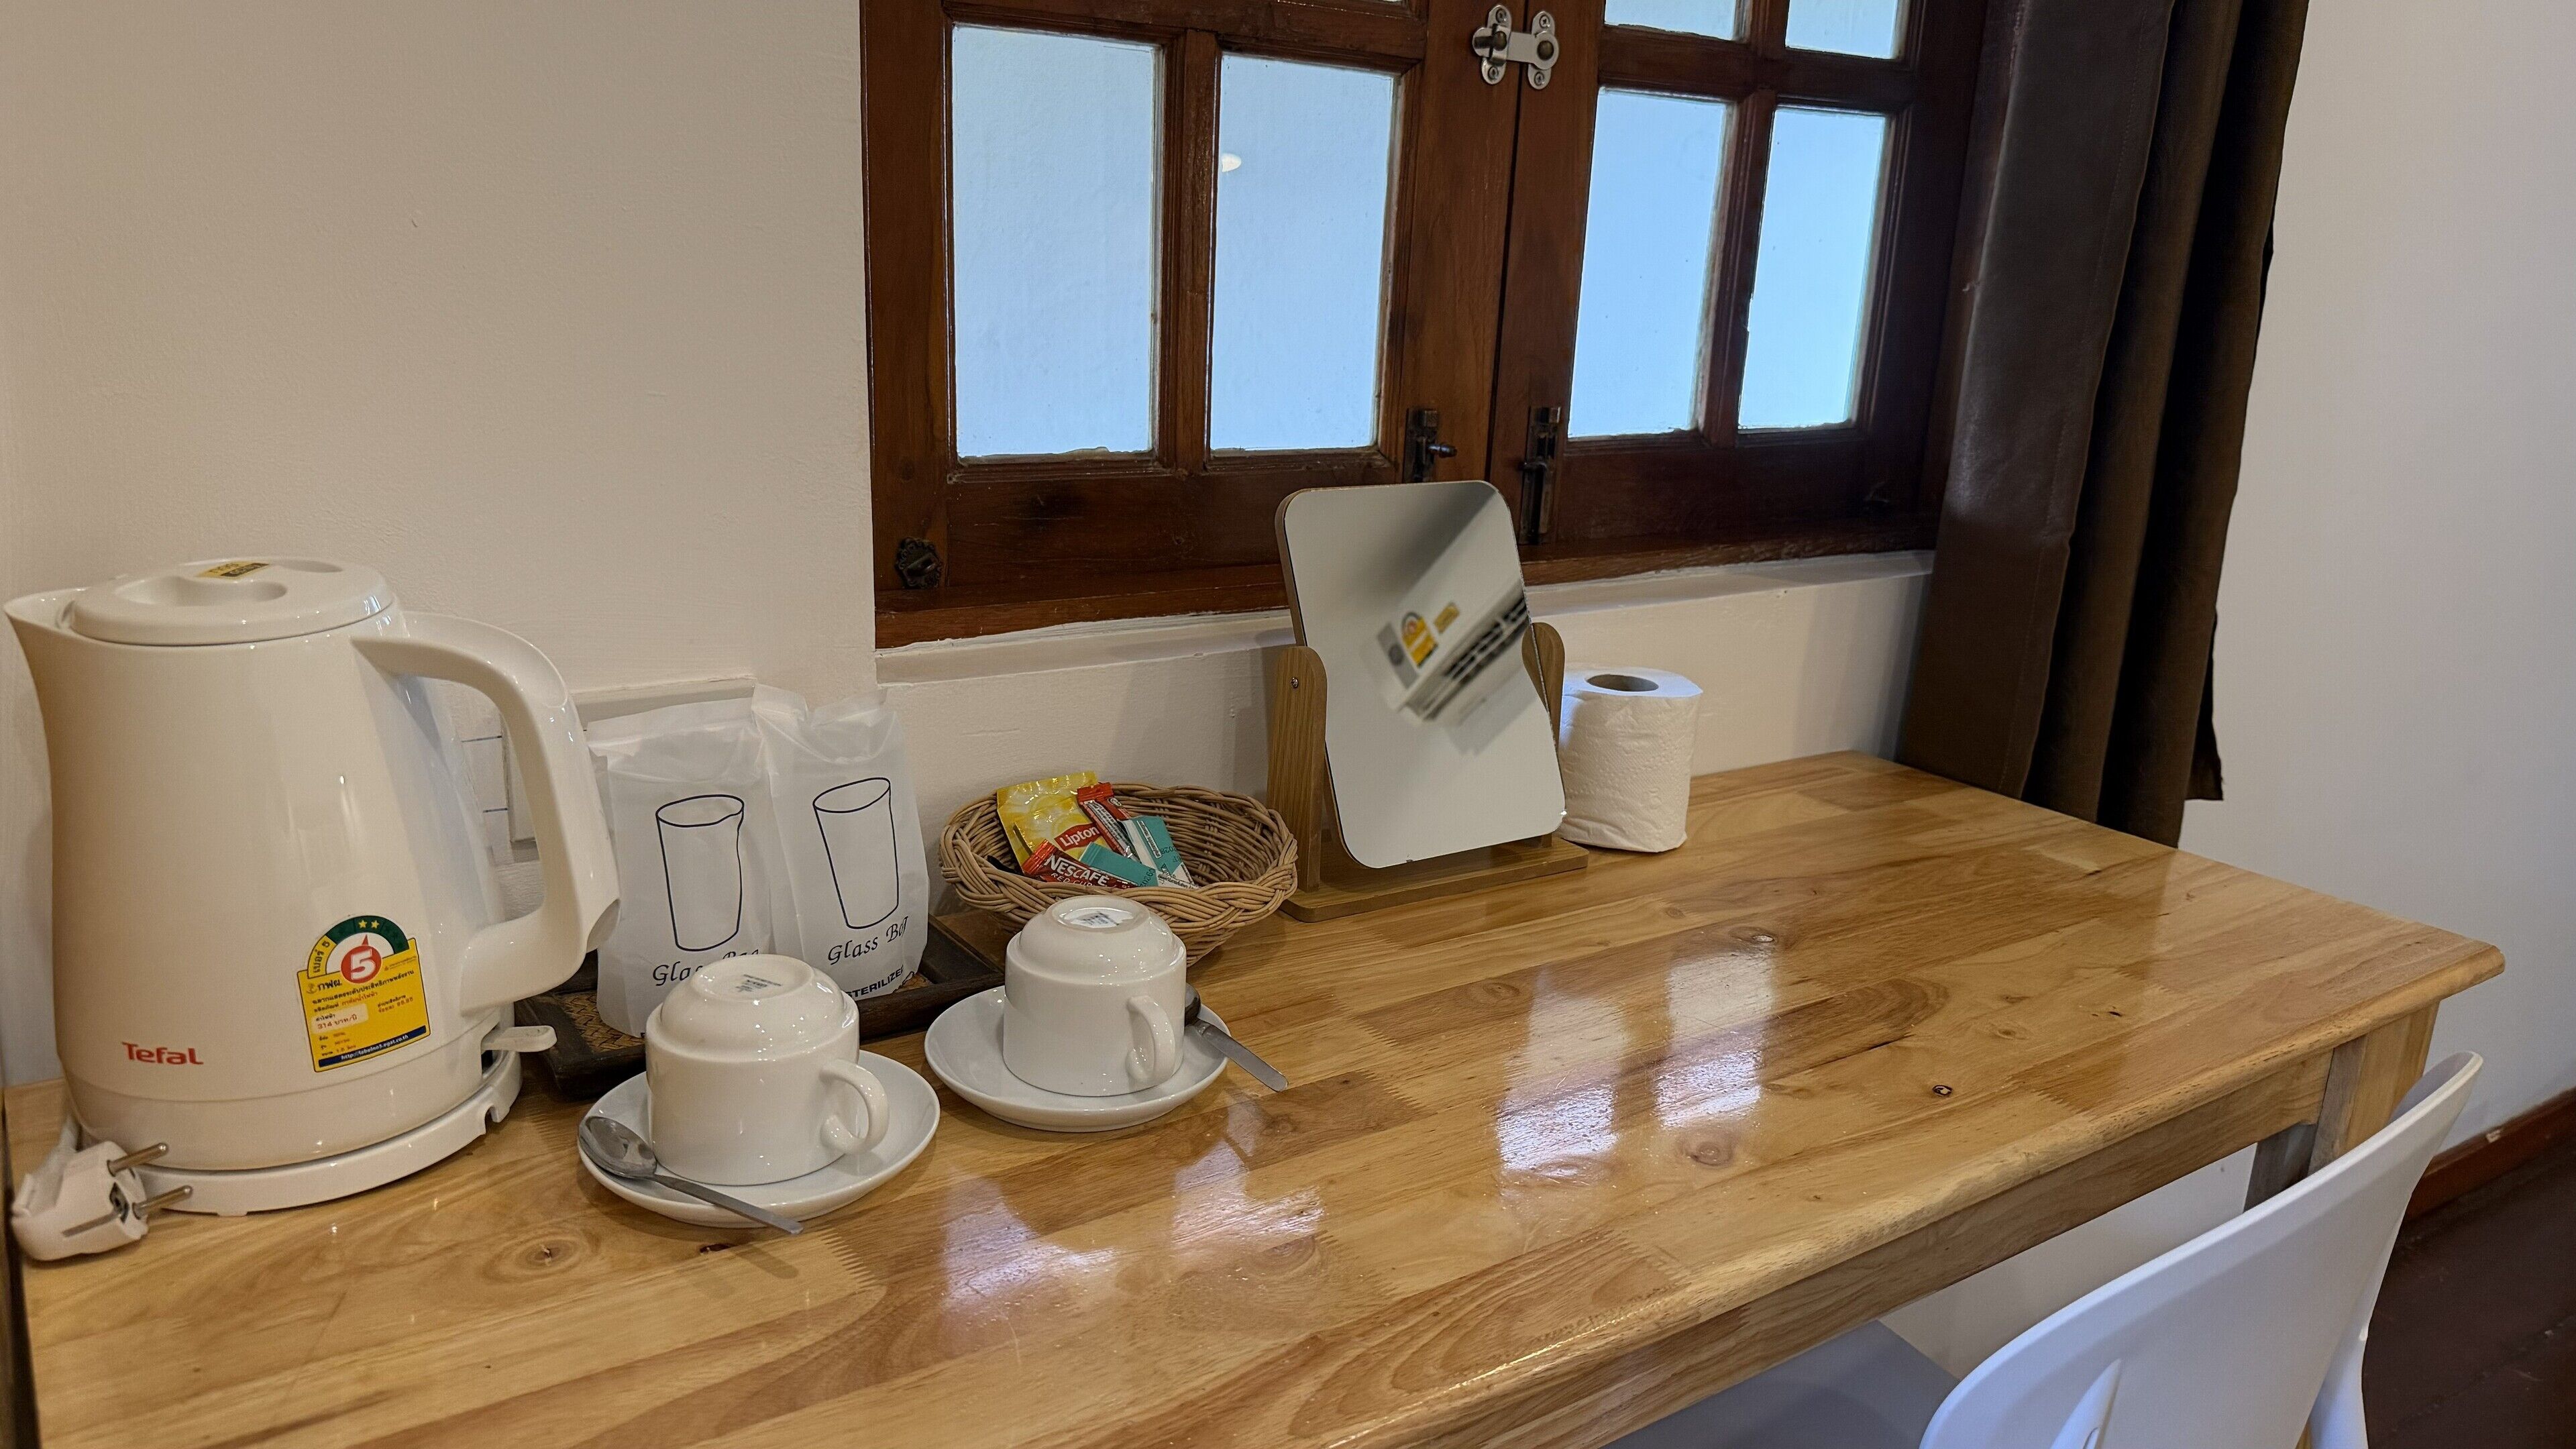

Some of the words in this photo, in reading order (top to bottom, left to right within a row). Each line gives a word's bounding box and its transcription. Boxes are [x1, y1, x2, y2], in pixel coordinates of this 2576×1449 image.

[1059, 826, 1100, 847] Lipton
[828, 936, 879, 966] Glass
[351, 949, 377, 981] 5
[317, 1021, 333, 1029] 314
[121, 1041, 204, 1065] Tefal
